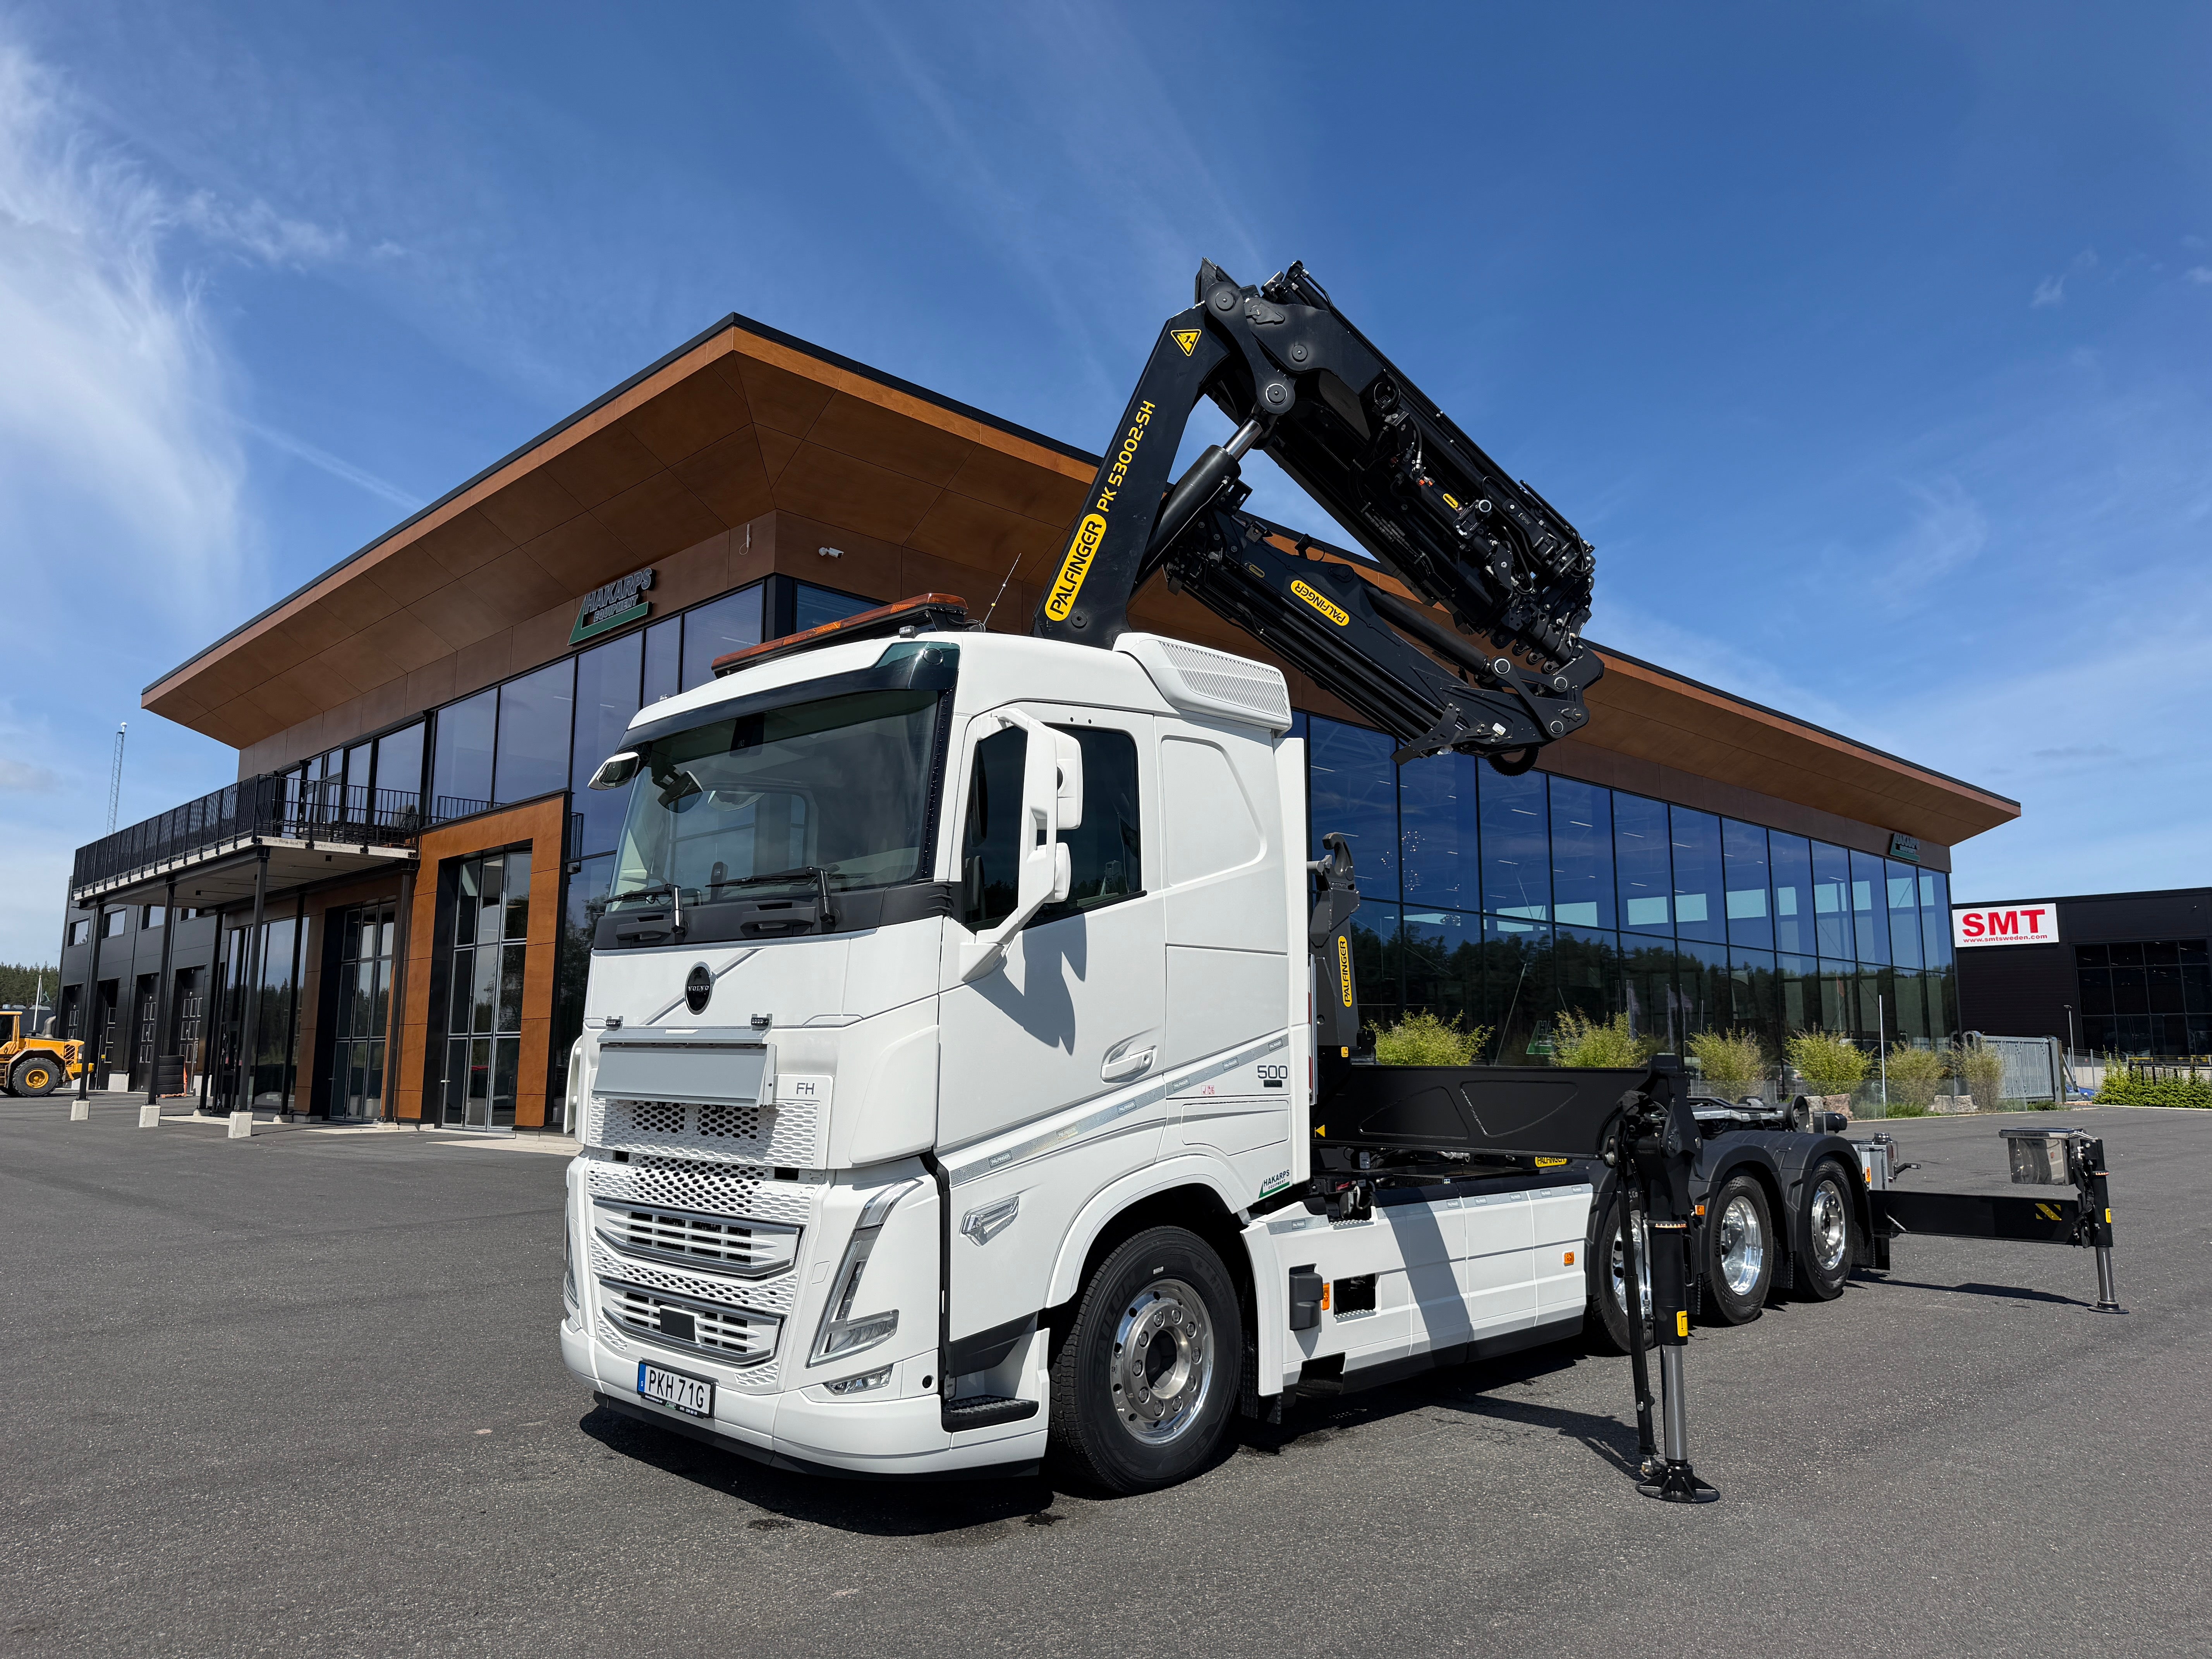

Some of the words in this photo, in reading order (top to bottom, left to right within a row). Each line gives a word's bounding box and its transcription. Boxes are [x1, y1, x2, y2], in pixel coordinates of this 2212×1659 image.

[1096, 486, 1117, 512] PK
[1108, 400, 1156, 487] 53002-SH
[1049, 520, 1103, 615] PALFINGER
[584, 568, 652, 615] HAKARPS
[1295, 582, 1346, 623] PALFINGER
[593, 594, 639, 622] EQUIPMENT
[1962, 909, 2045, 937] SMT
[1963, 934, 2047, 943] www.smtsweden.com
[1340, 941, 1350, 1002] PALFINGER
[1257, 1065, 1288, 1079] 500
[796, 1082, 815, 1095] FH
[991, 1154, 1010, 1164] PALFINGER
[1264, 1169, 1290, 1187] HAKARPS
[649, 1369, 674, 1399] PKH
[678, 1378, 704, 1408] 71G
